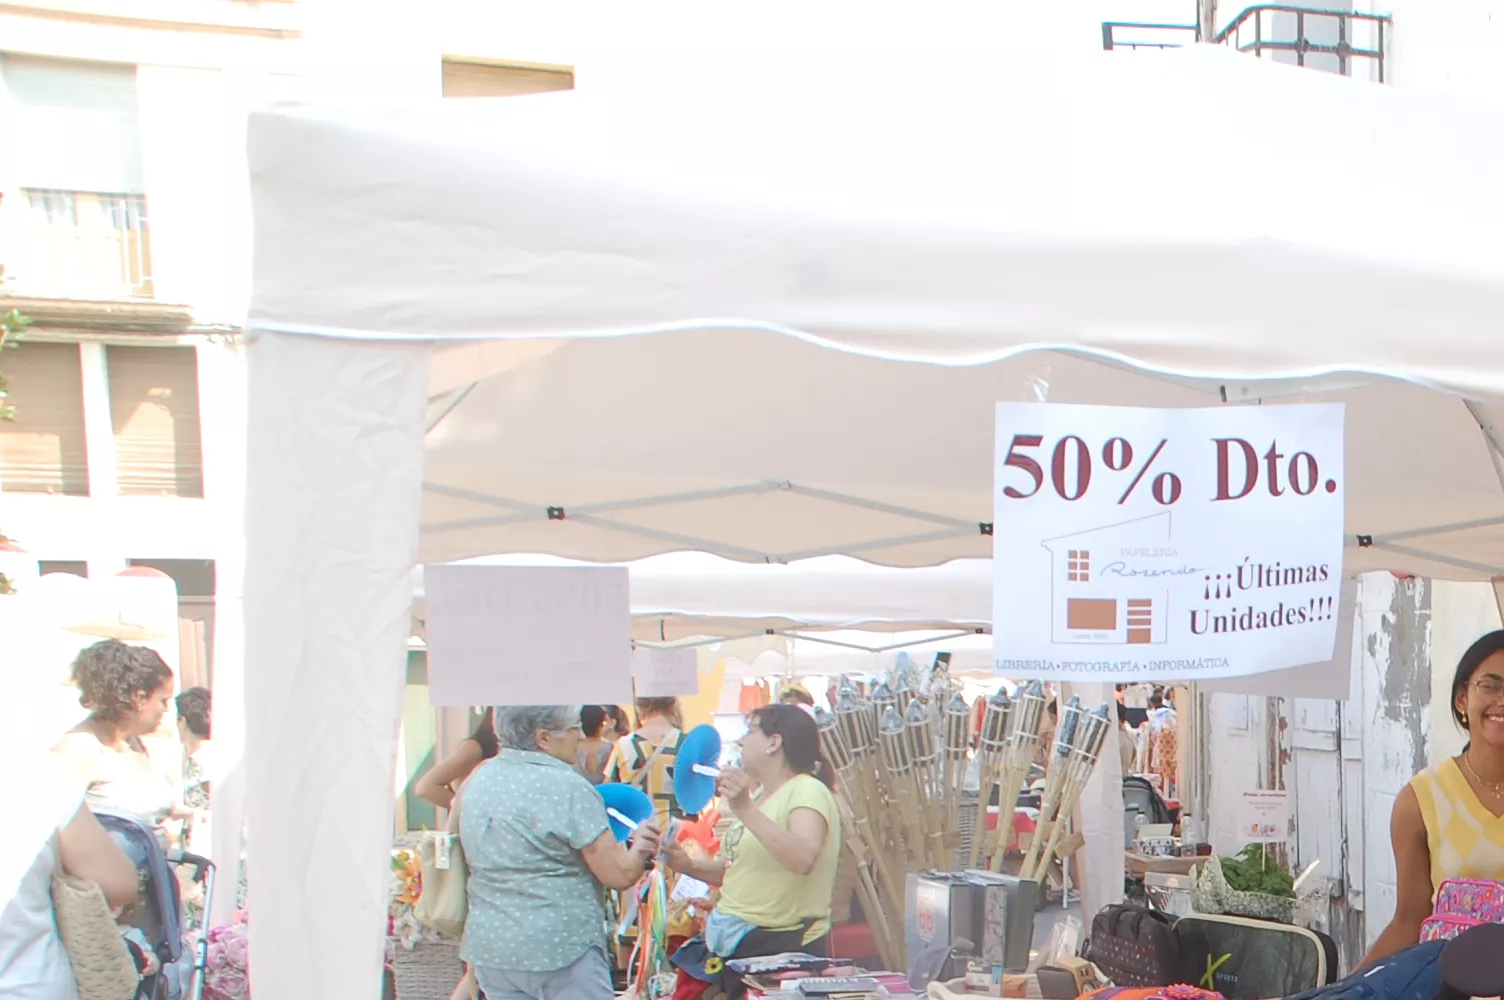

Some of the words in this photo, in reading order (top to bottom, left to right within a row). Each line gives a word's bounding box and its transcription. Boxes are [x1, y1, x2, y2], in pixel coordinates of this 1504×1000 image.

[1002, 433, 1183, 506] 50%
[1209, 437, 1338, 502] Dto.
[1203, 555, 1330, 601] ¡¡¡Últimas
[1188, 596, 1334, 636] Unidades!!!
